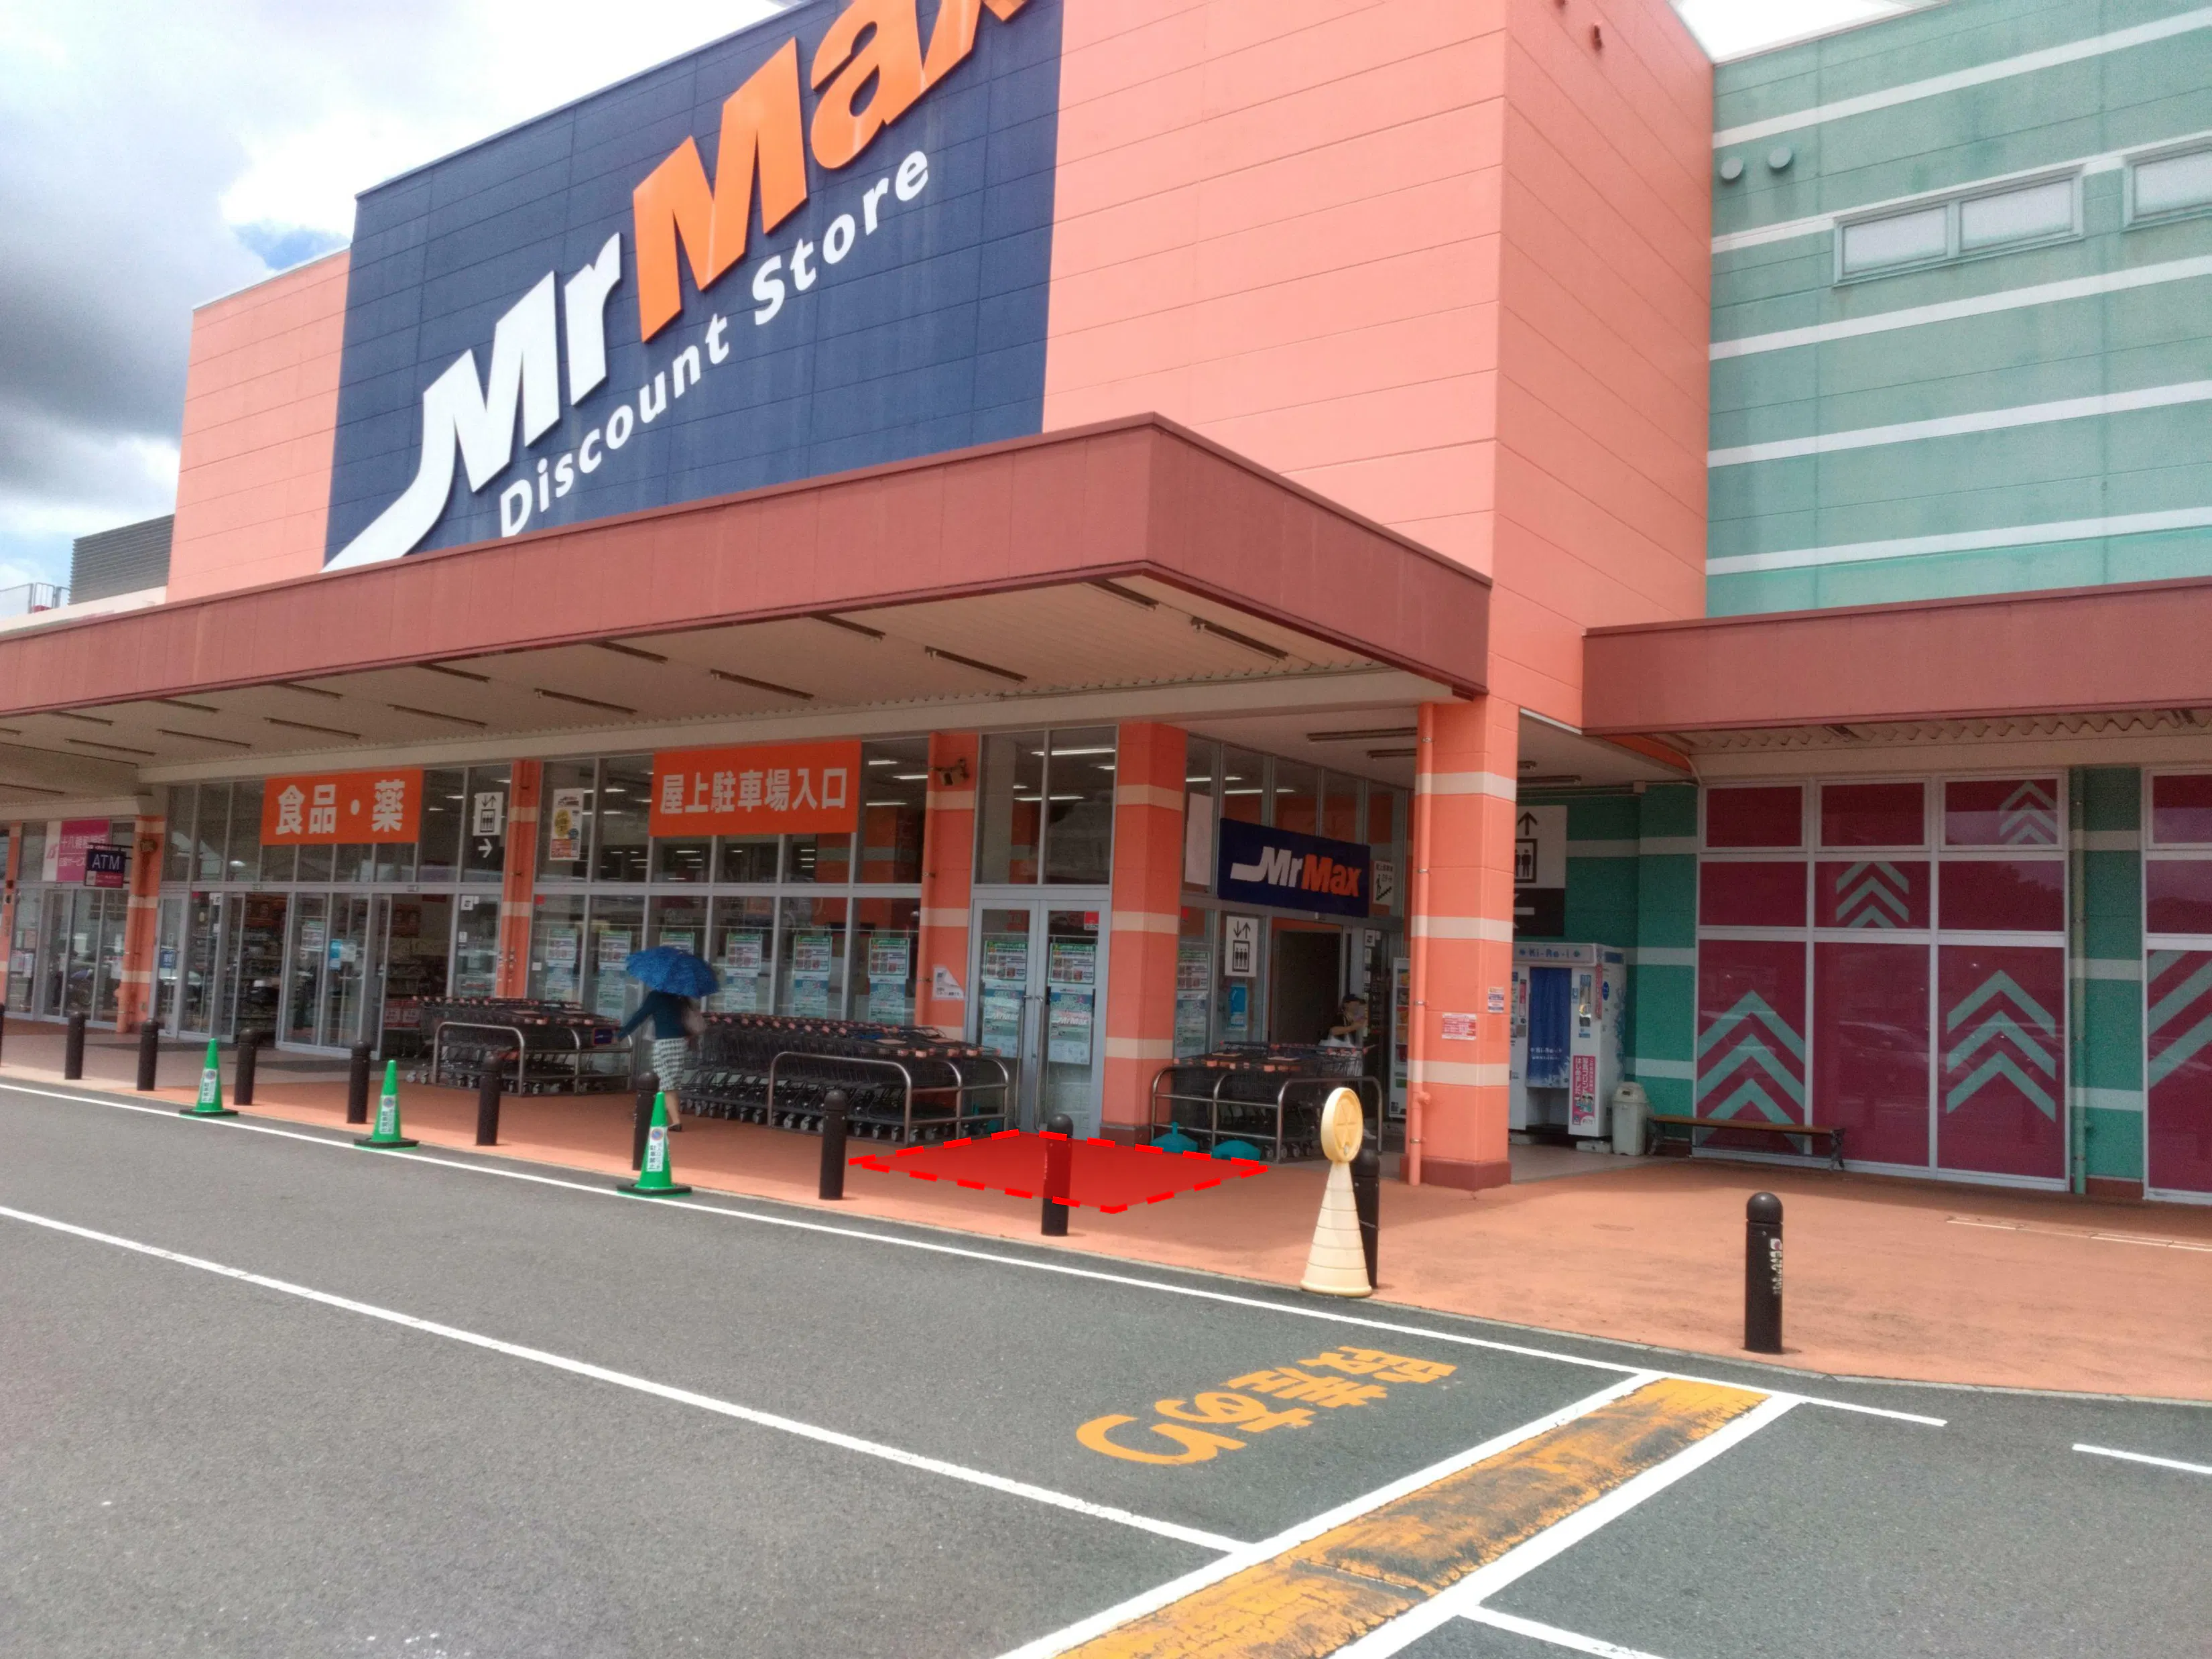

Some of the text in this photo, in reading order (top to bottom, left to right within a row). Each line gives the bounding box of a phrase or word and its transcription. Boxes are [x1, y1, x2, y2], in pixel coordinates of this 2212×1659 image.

[500, 151, 929, 539] Discount Store
[275, 779, 406, 835] 食品・薬
[660, 767, 848, 815] 屋上駐車場入口
[92, 854, 121, 871] ATM
[1229, 846, 1362, 898] MrMax
[1075, 1345, 1457, 1465] 段差あり
